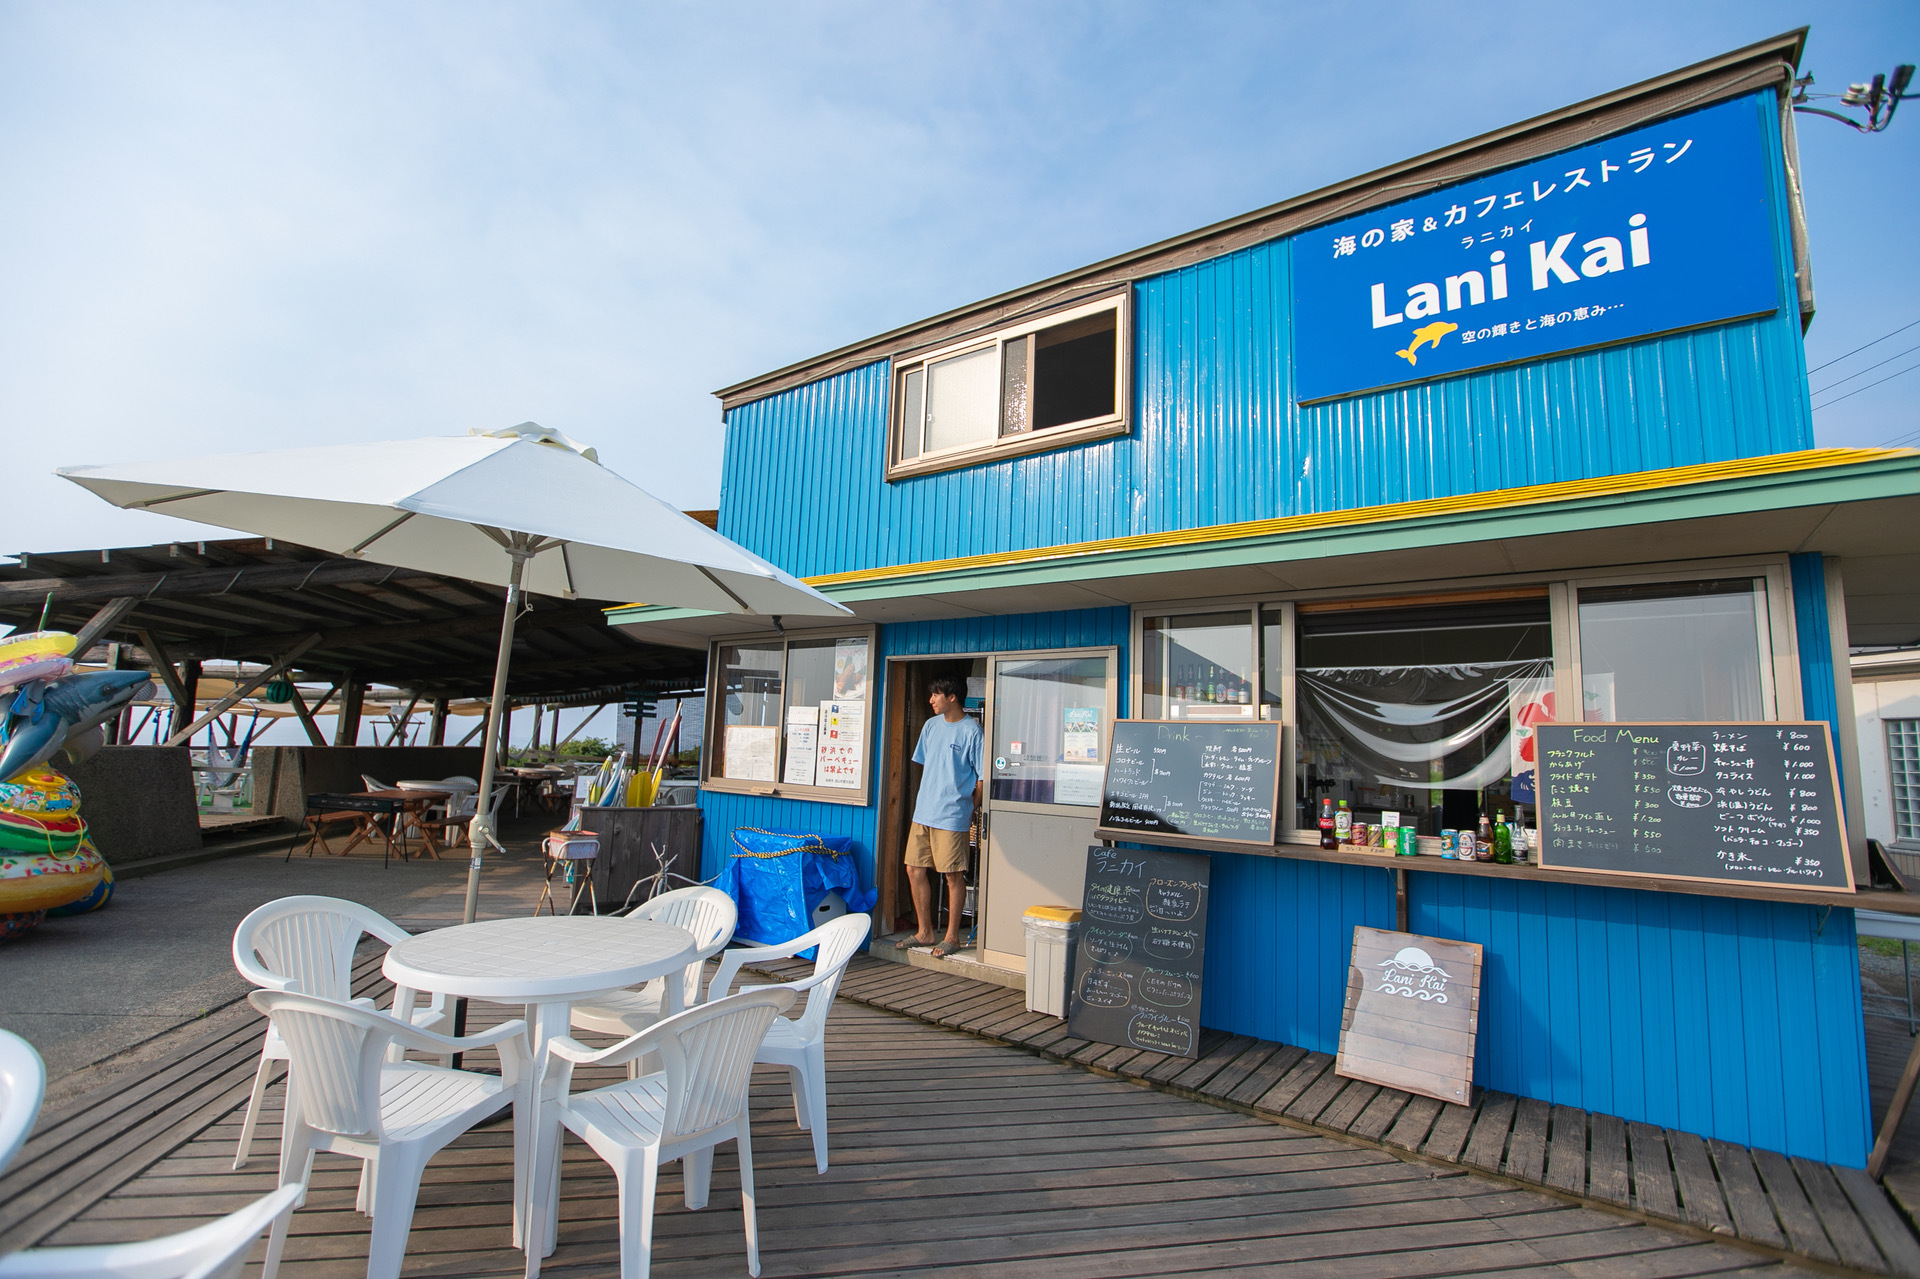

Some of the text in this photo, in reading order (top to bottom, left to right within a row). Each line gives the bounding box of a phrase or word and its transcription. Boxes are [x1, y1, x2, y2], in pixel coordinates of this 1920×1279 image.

[1461, 219, 1534, 250] ラニカイ
[1371, 213, 1651, 329] Lani Kai
[1157, 725, 1190, 742] Drink
[1573, 728, 1660, 744] Food Menu
[1712, 730, 1748, 741] ラーメン
[821, 746, 853, 755] 砂浜での
[1115, 743, 1141, 754] 生ビール
[1671, 740, 1702, 753] 夏野菜
[1712, 743, 1748, 753] 焼そば
[1547, 749, 1596, 758] フランクフルト
[820, 755, 859, 765] バーベキュー
[1115, 757, 1145, 765] コロナビール
[1549, 759, 1586, 770] からあげ
[1715, 771, 1754, 781] タコライス
[1550, 783, 1590, 795] たこ焼き
[1550, 797, 1574, 808] 枝豆
[1093, 847, 1117, 859] Cafe
[1716, 849, 1753, 863] かき氷
[1096, 857, 1147, 879] ラニカイ
[1381, 968, 1448, 992] Lani Kai
